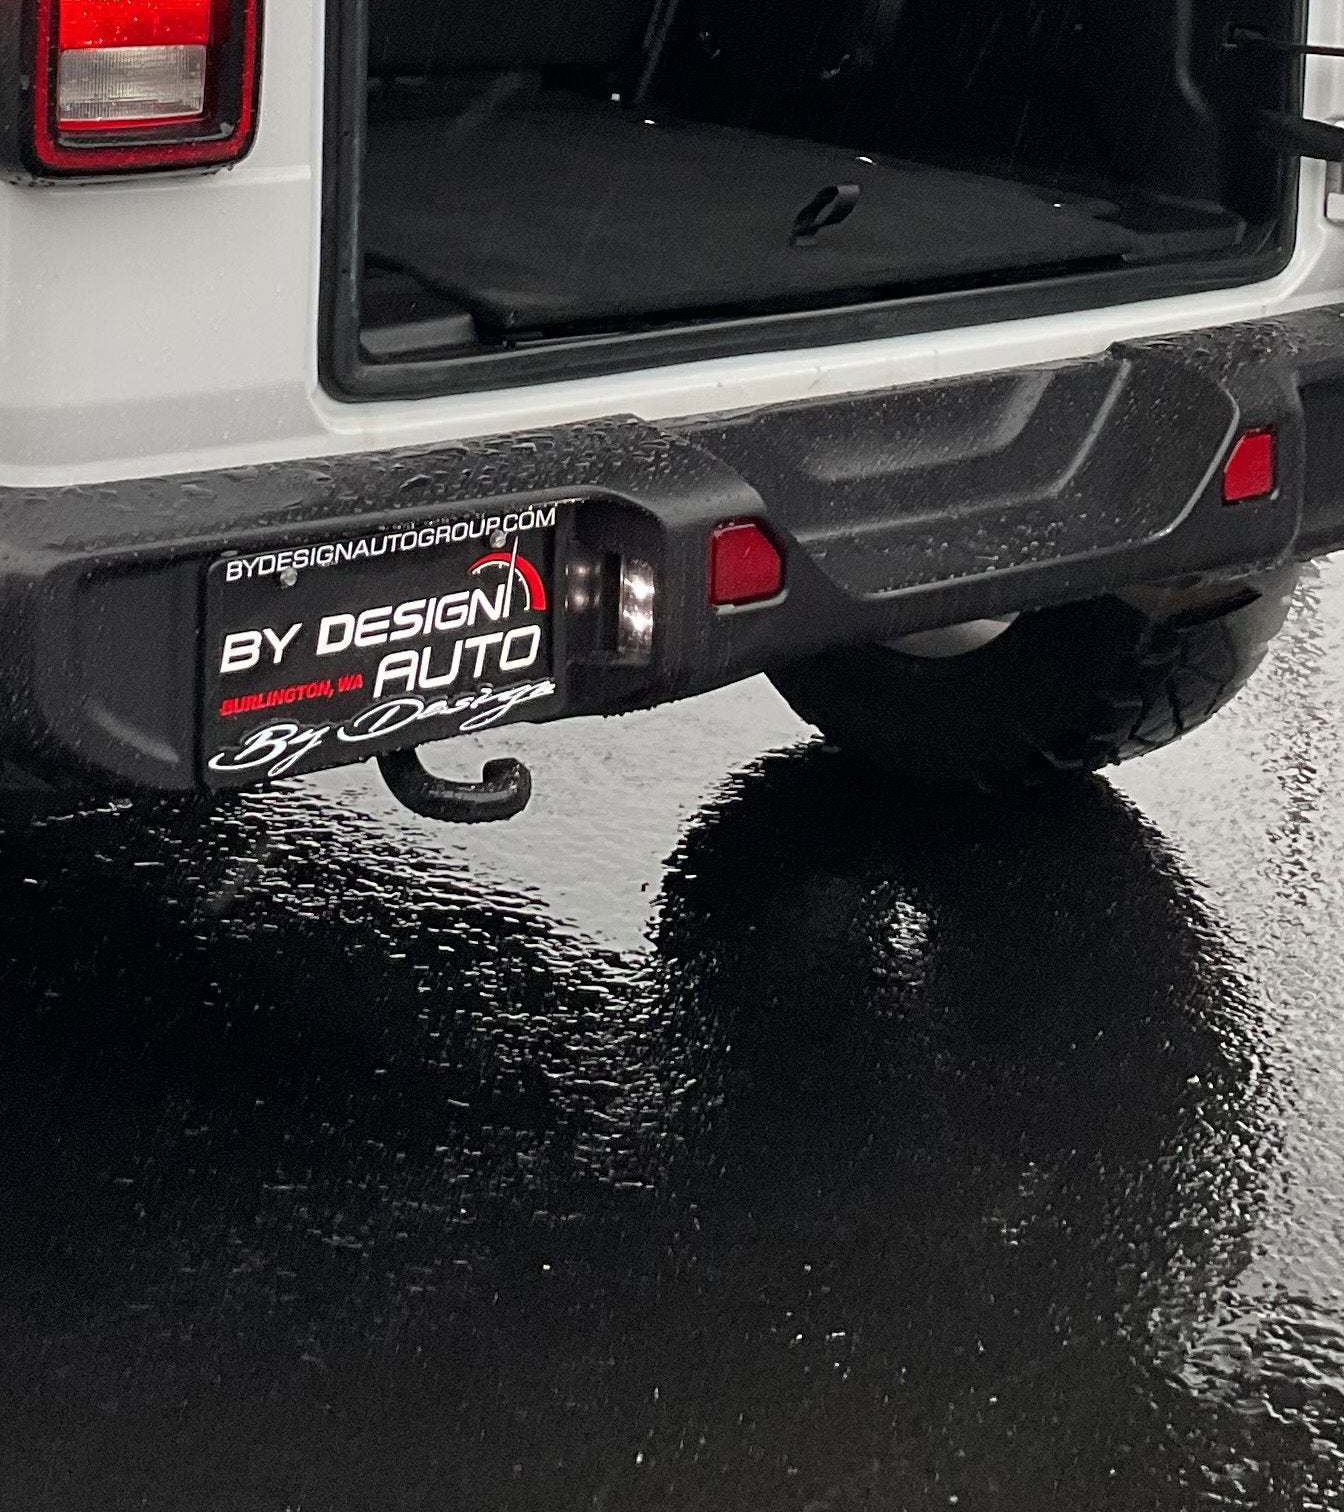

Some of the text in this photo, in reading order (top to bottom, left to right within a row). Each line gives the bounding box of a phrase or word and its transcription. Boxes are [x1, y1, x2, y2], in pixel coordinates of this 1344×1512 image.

[225, 510, 556, 582] BYDESIGNAUTOGROUPCOM
[220, 584, 507, 673] BY DESIGN
[373, 625, 541, 698] AUTO
[208, 682, 556, 777] By Design
[220, 674, 363, 717] BURLINGTON, WA
